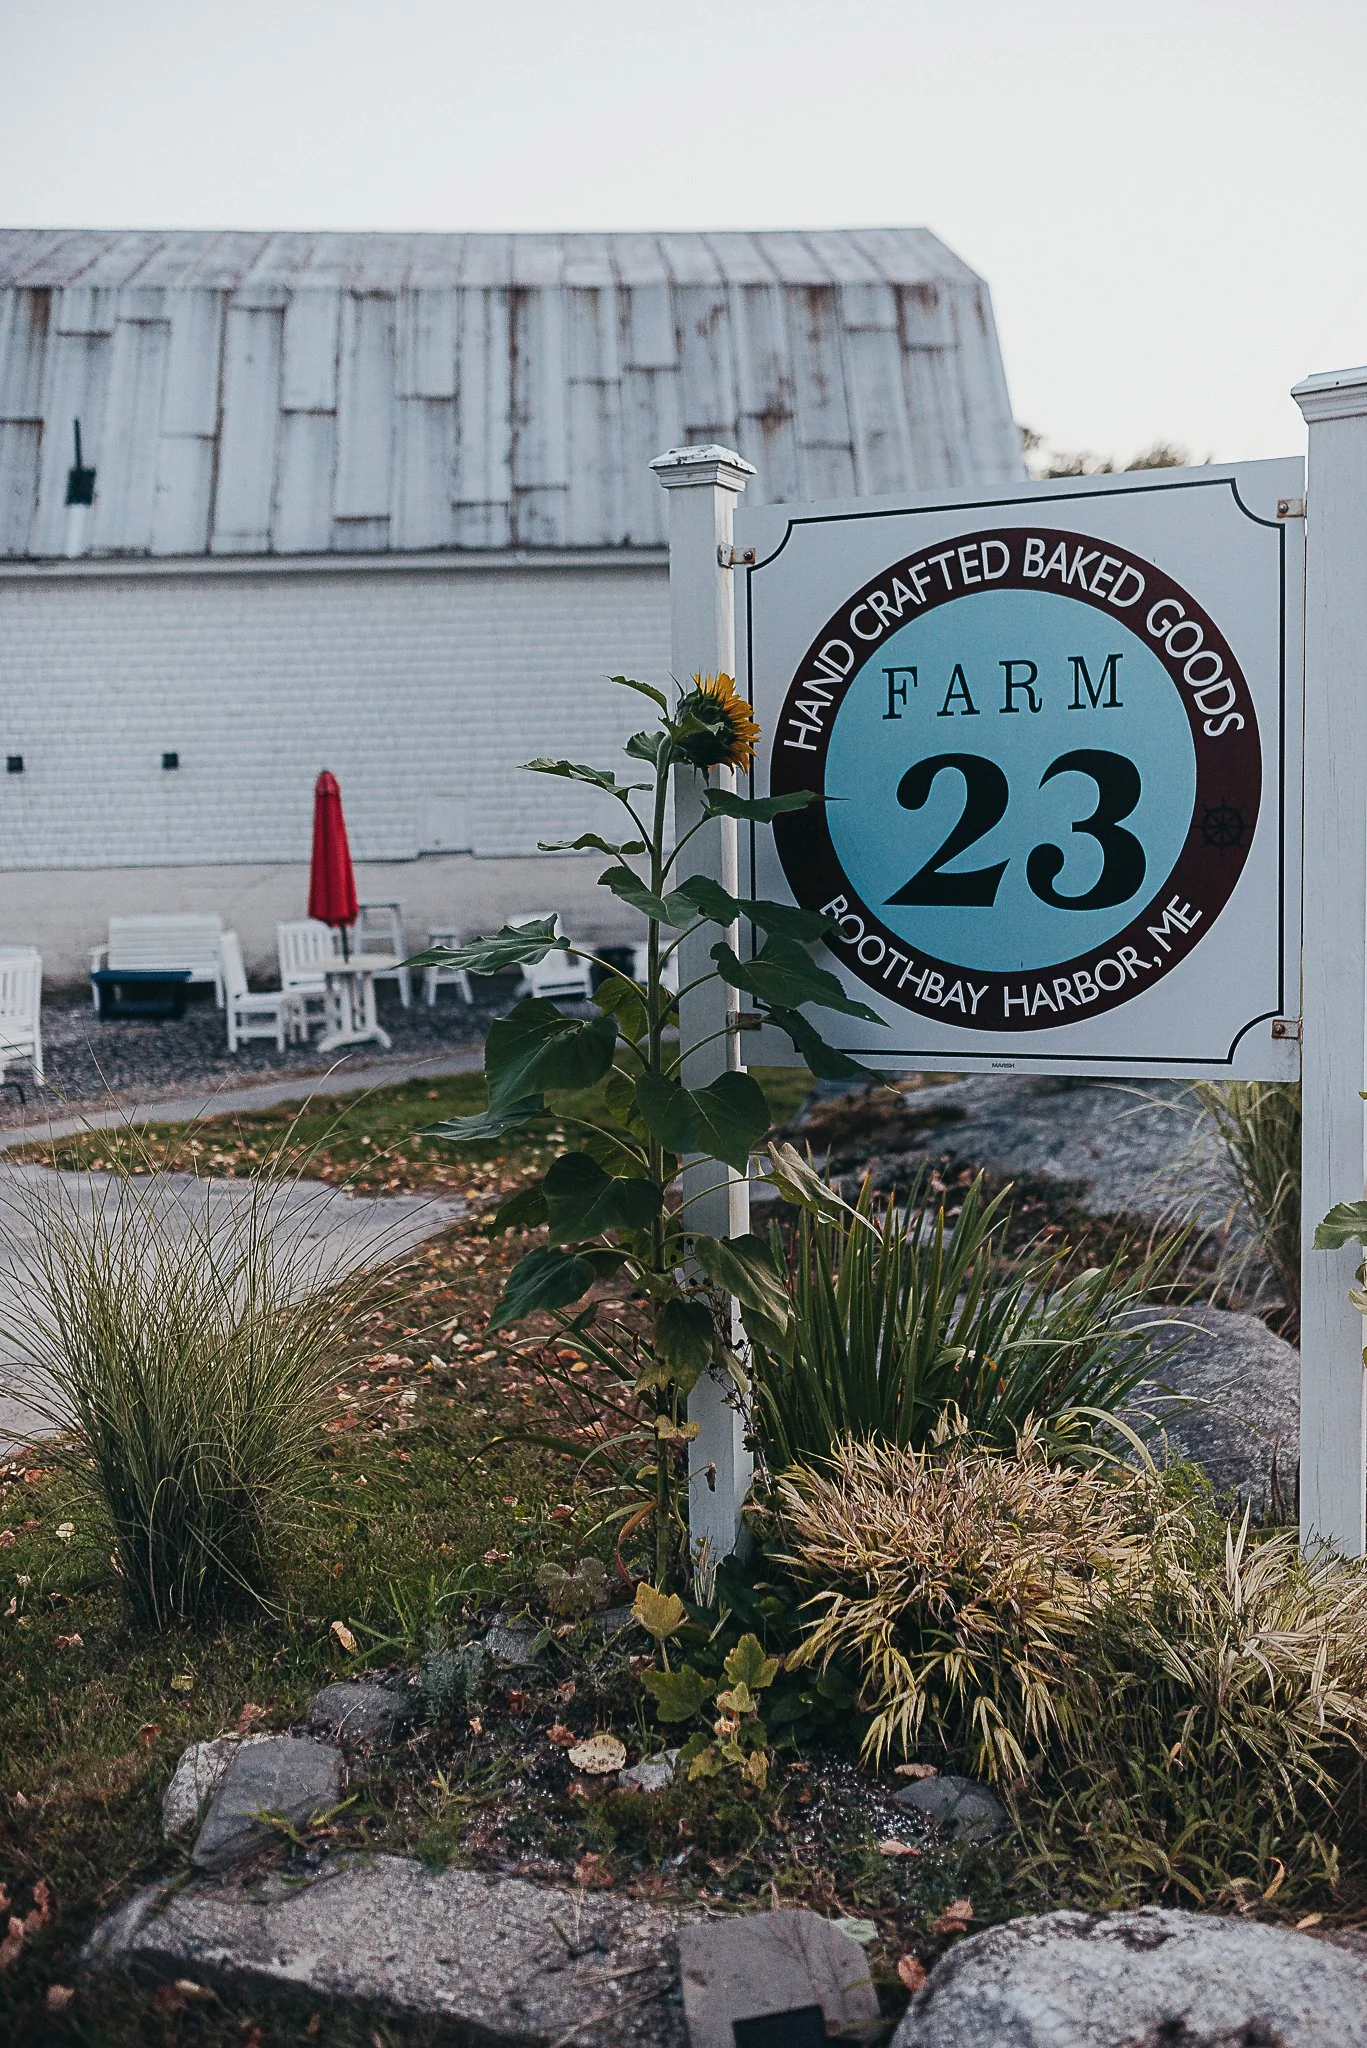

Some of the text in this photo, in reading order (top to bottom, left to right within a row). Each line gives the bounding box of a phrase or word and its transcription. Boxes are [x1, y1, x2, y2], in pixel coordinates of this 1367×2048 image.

[783, 537, 1245, 751] HAND CRAFTED BAKED GOODS
[881, 653, 1124, 721] FARM
[881, 748, 1147, 911] 23
[819, 894, 1203, 1017] BOOTHBAY HARBOR, ME
